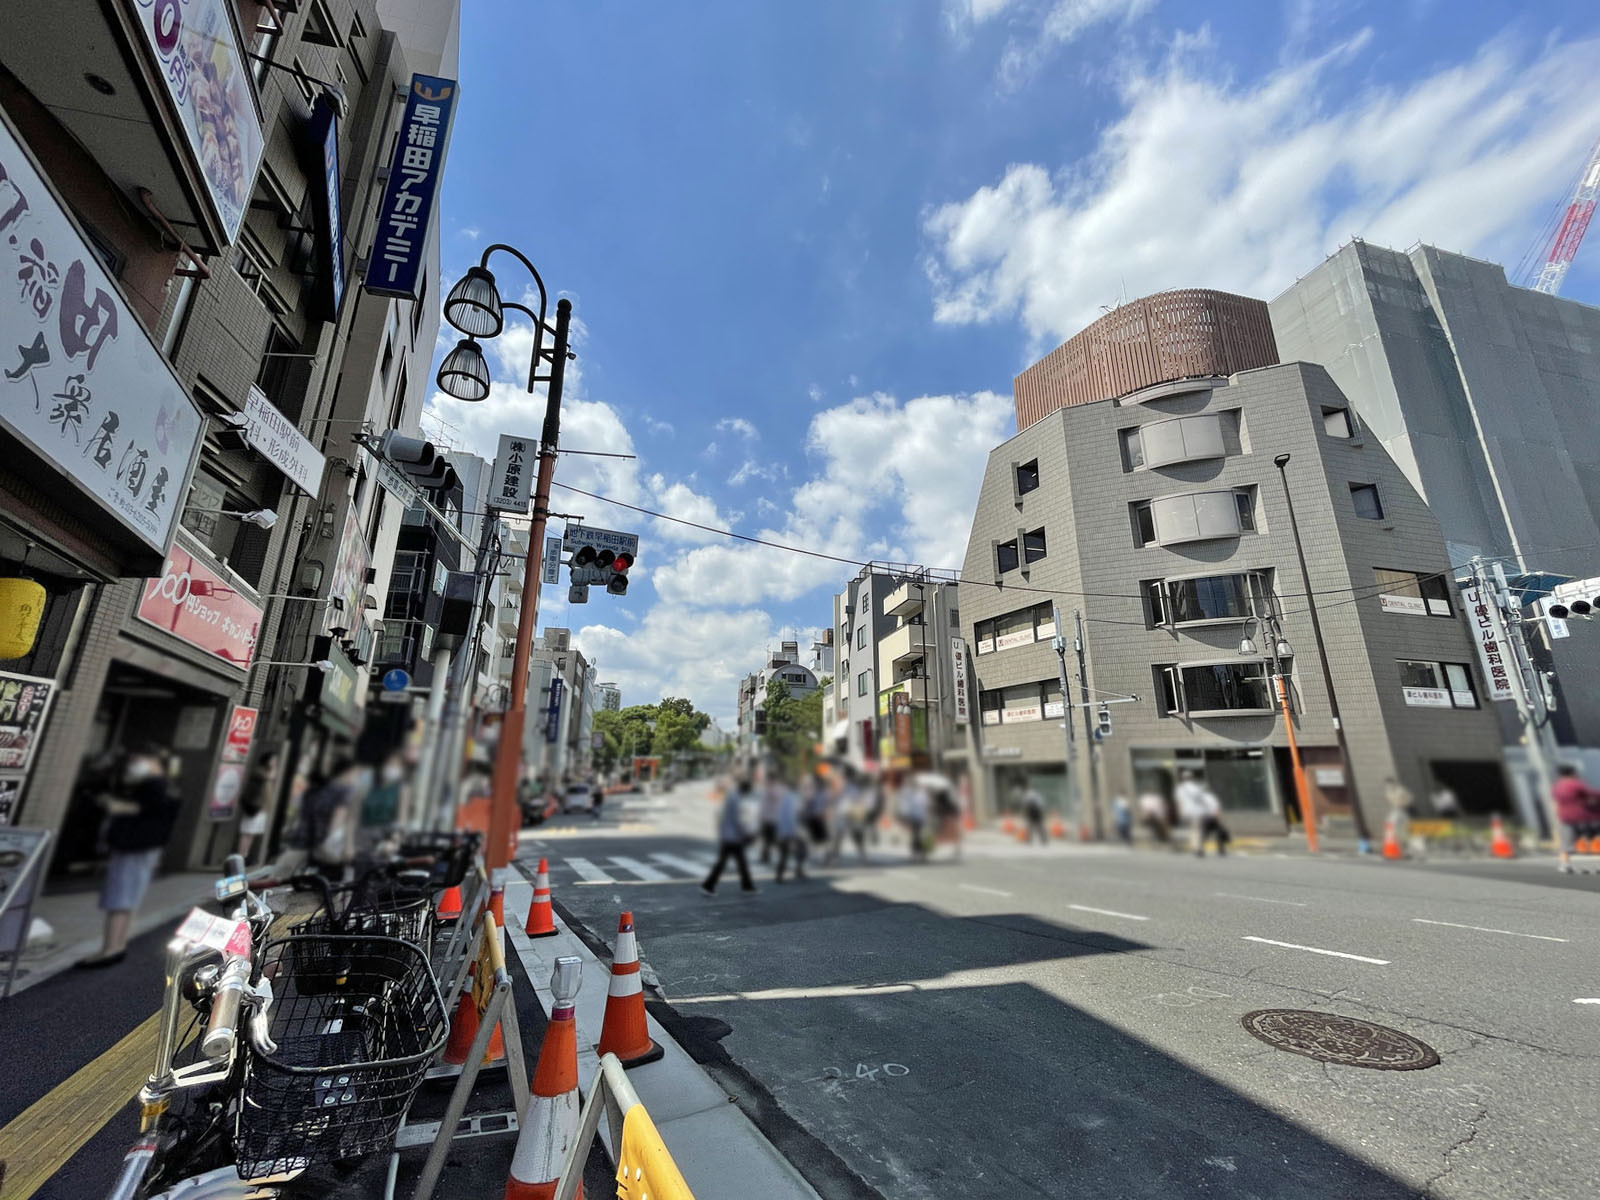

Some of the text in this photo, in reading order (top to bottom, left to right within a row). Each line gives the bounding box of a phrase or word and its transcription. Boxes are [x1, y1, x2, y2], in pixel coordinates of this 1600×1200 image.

[384, 104, 441, 282] 早稲田アカデミー
[248, 391, 300, 452] 早稲田駅前
